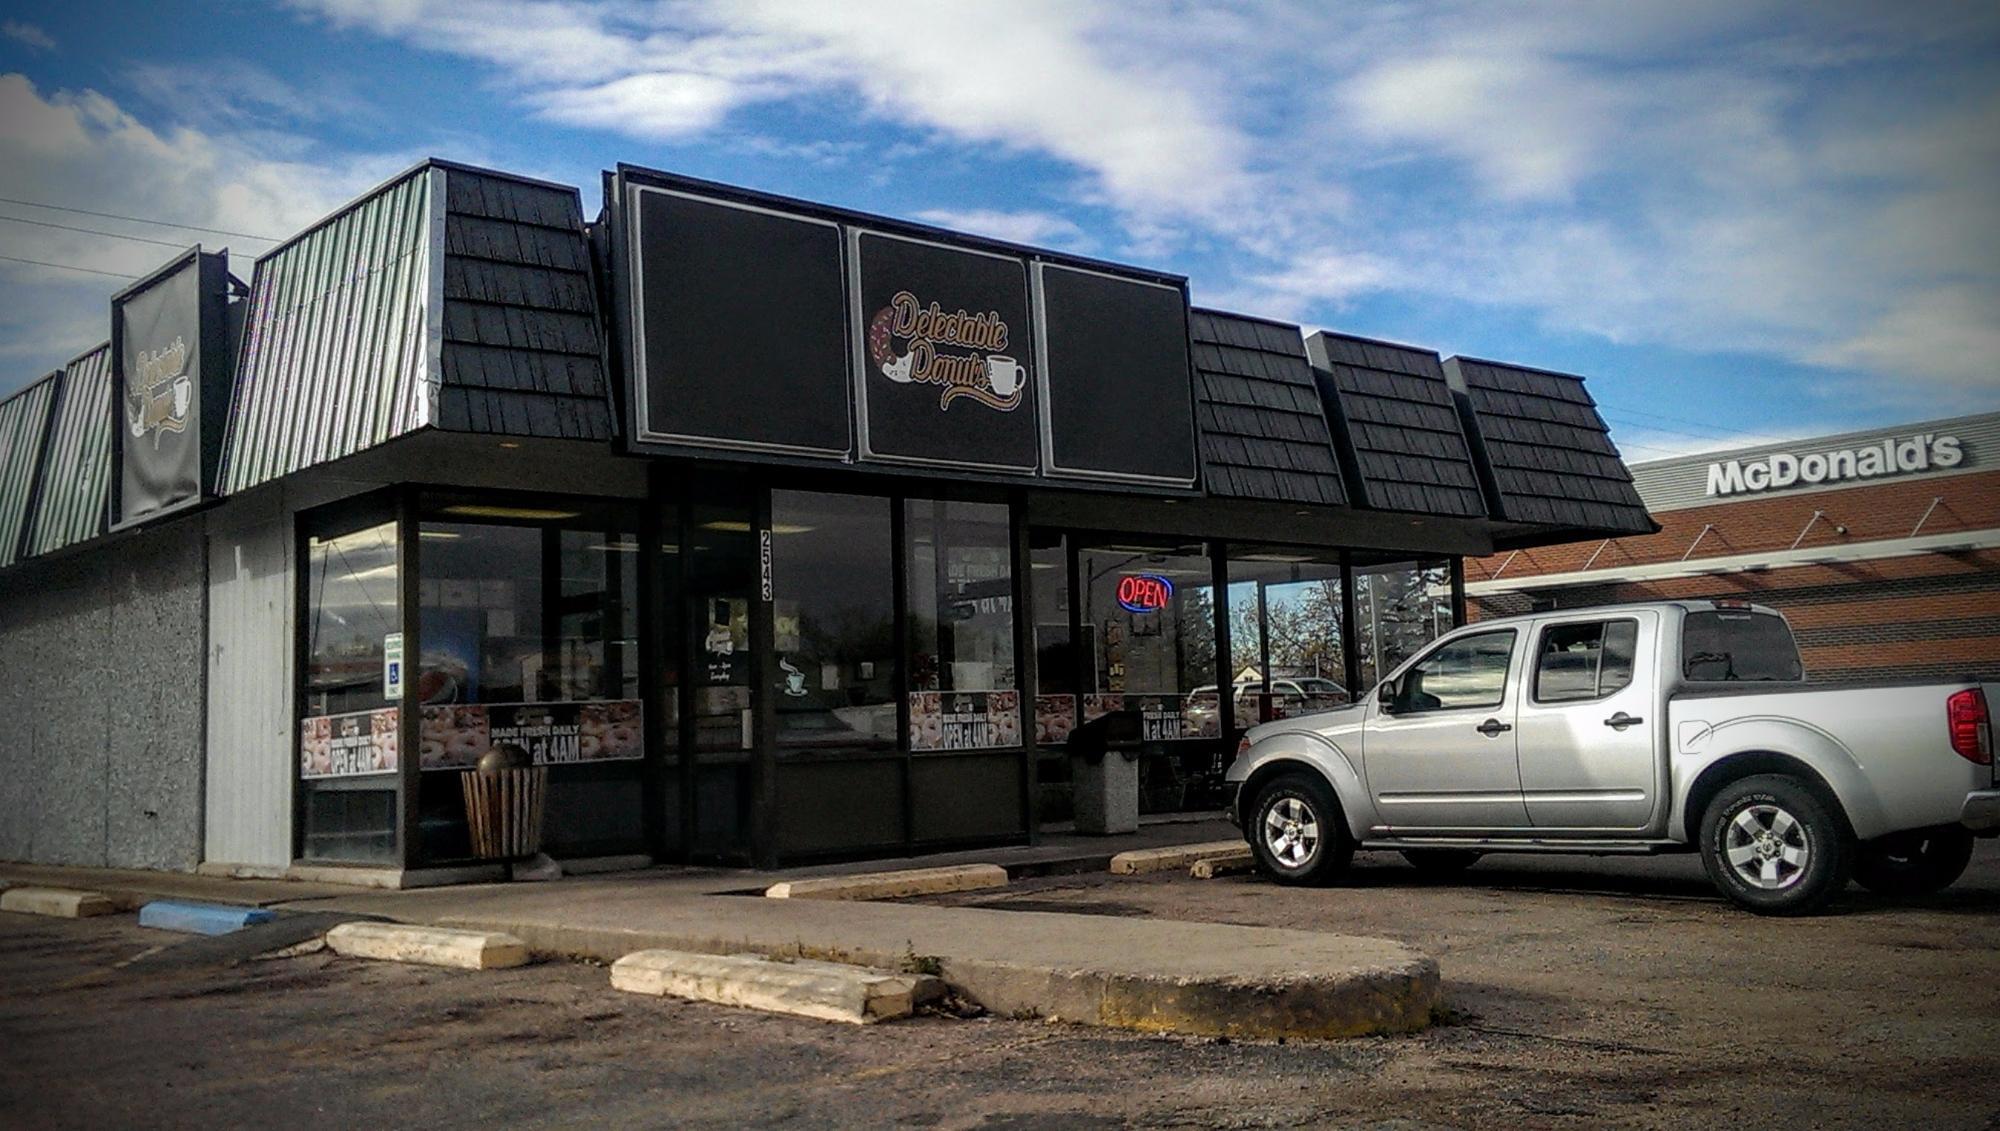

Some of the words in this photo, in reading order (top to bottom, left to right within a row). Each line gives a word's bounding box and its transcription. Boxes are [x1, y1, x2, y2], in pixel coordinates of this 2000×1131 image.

[892, 291, 1009, 352] Delectable
[907, 338, 992, 389] Donuts
[1706, 433, 1963, 495] McDonald's
[761, 530, 772, 600] 2543
[1118, 576, 1168, 609] OPEN
[491, 727, 518, 739] MADE
[519, 726, 551, 738] FRESH
[552, 724, 580, 736] DAILY
[533, 737, 549, 766] at
[550, 735, 580, 764] 4AM
